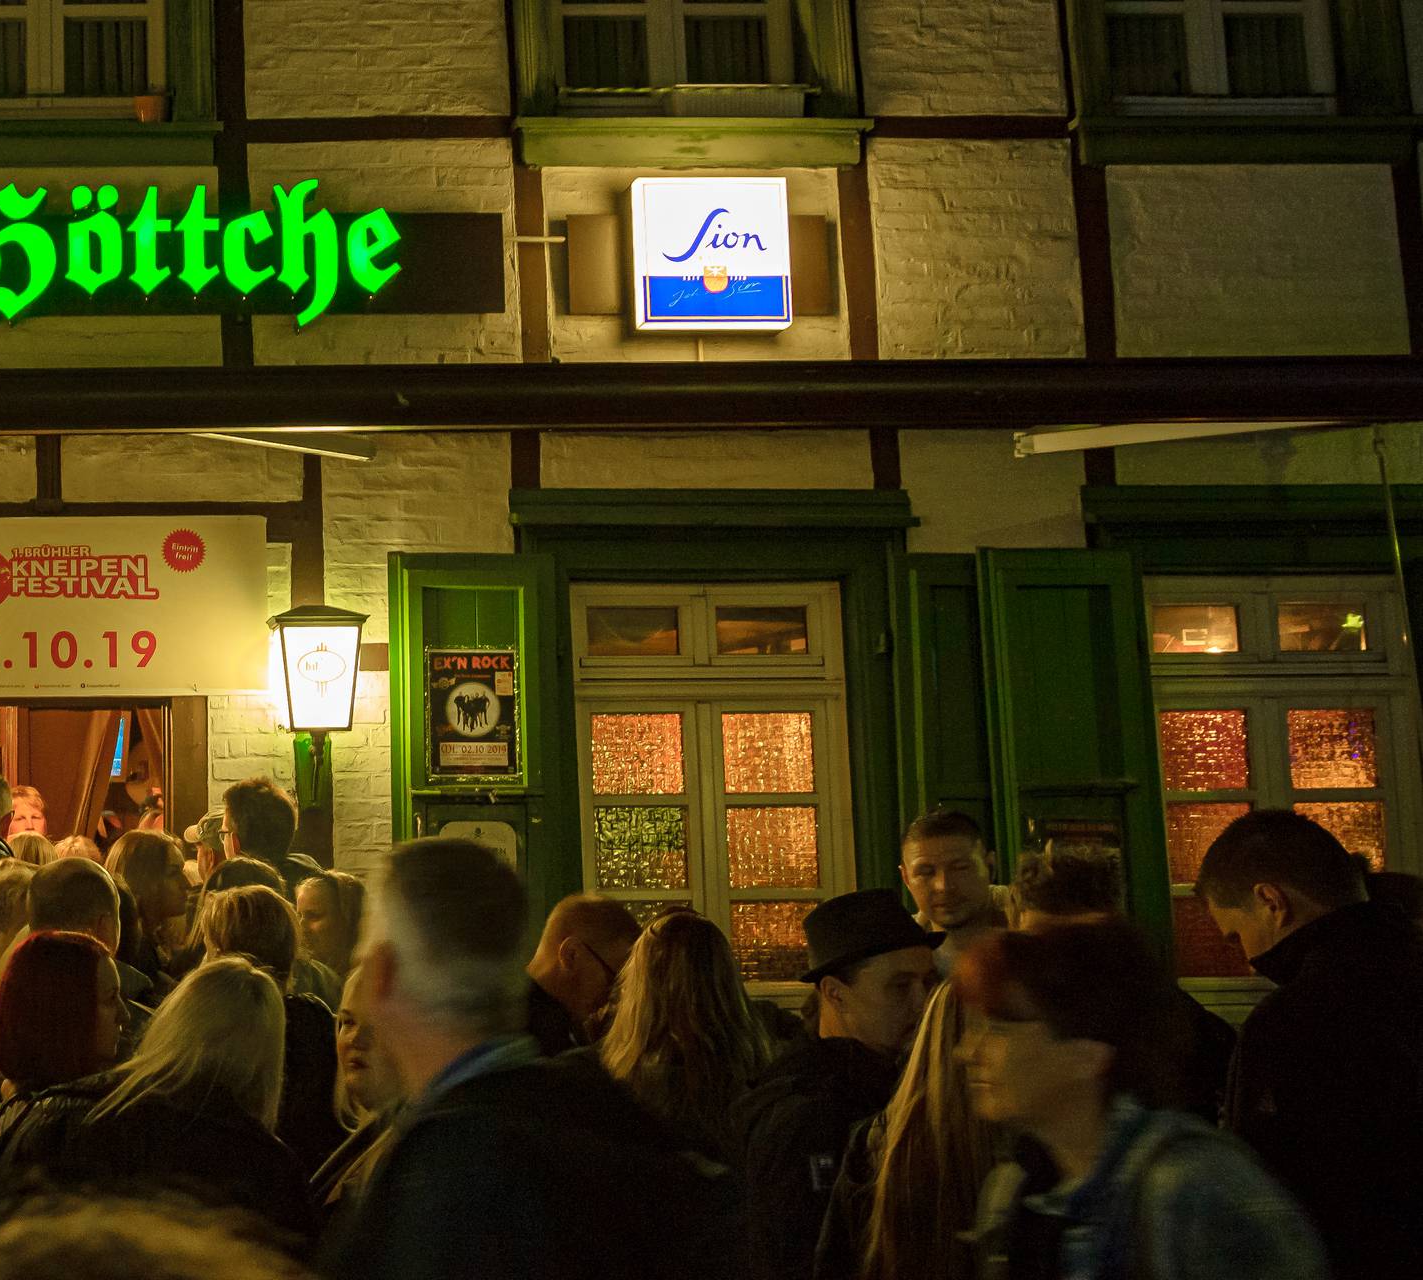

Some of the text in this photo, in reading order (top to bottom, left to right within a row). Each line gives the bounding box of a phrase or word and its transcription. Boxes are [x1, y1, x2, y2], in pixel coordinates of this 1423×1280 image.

[662, 208, 768, 262] Sion
[25, 545, 90, 558] BRÜHLER
[12, 557, 145, 577] KNEIPEN
[12, 577, 157, 596] FESTIVAL
[471, 655, 511, 670] ROCK
